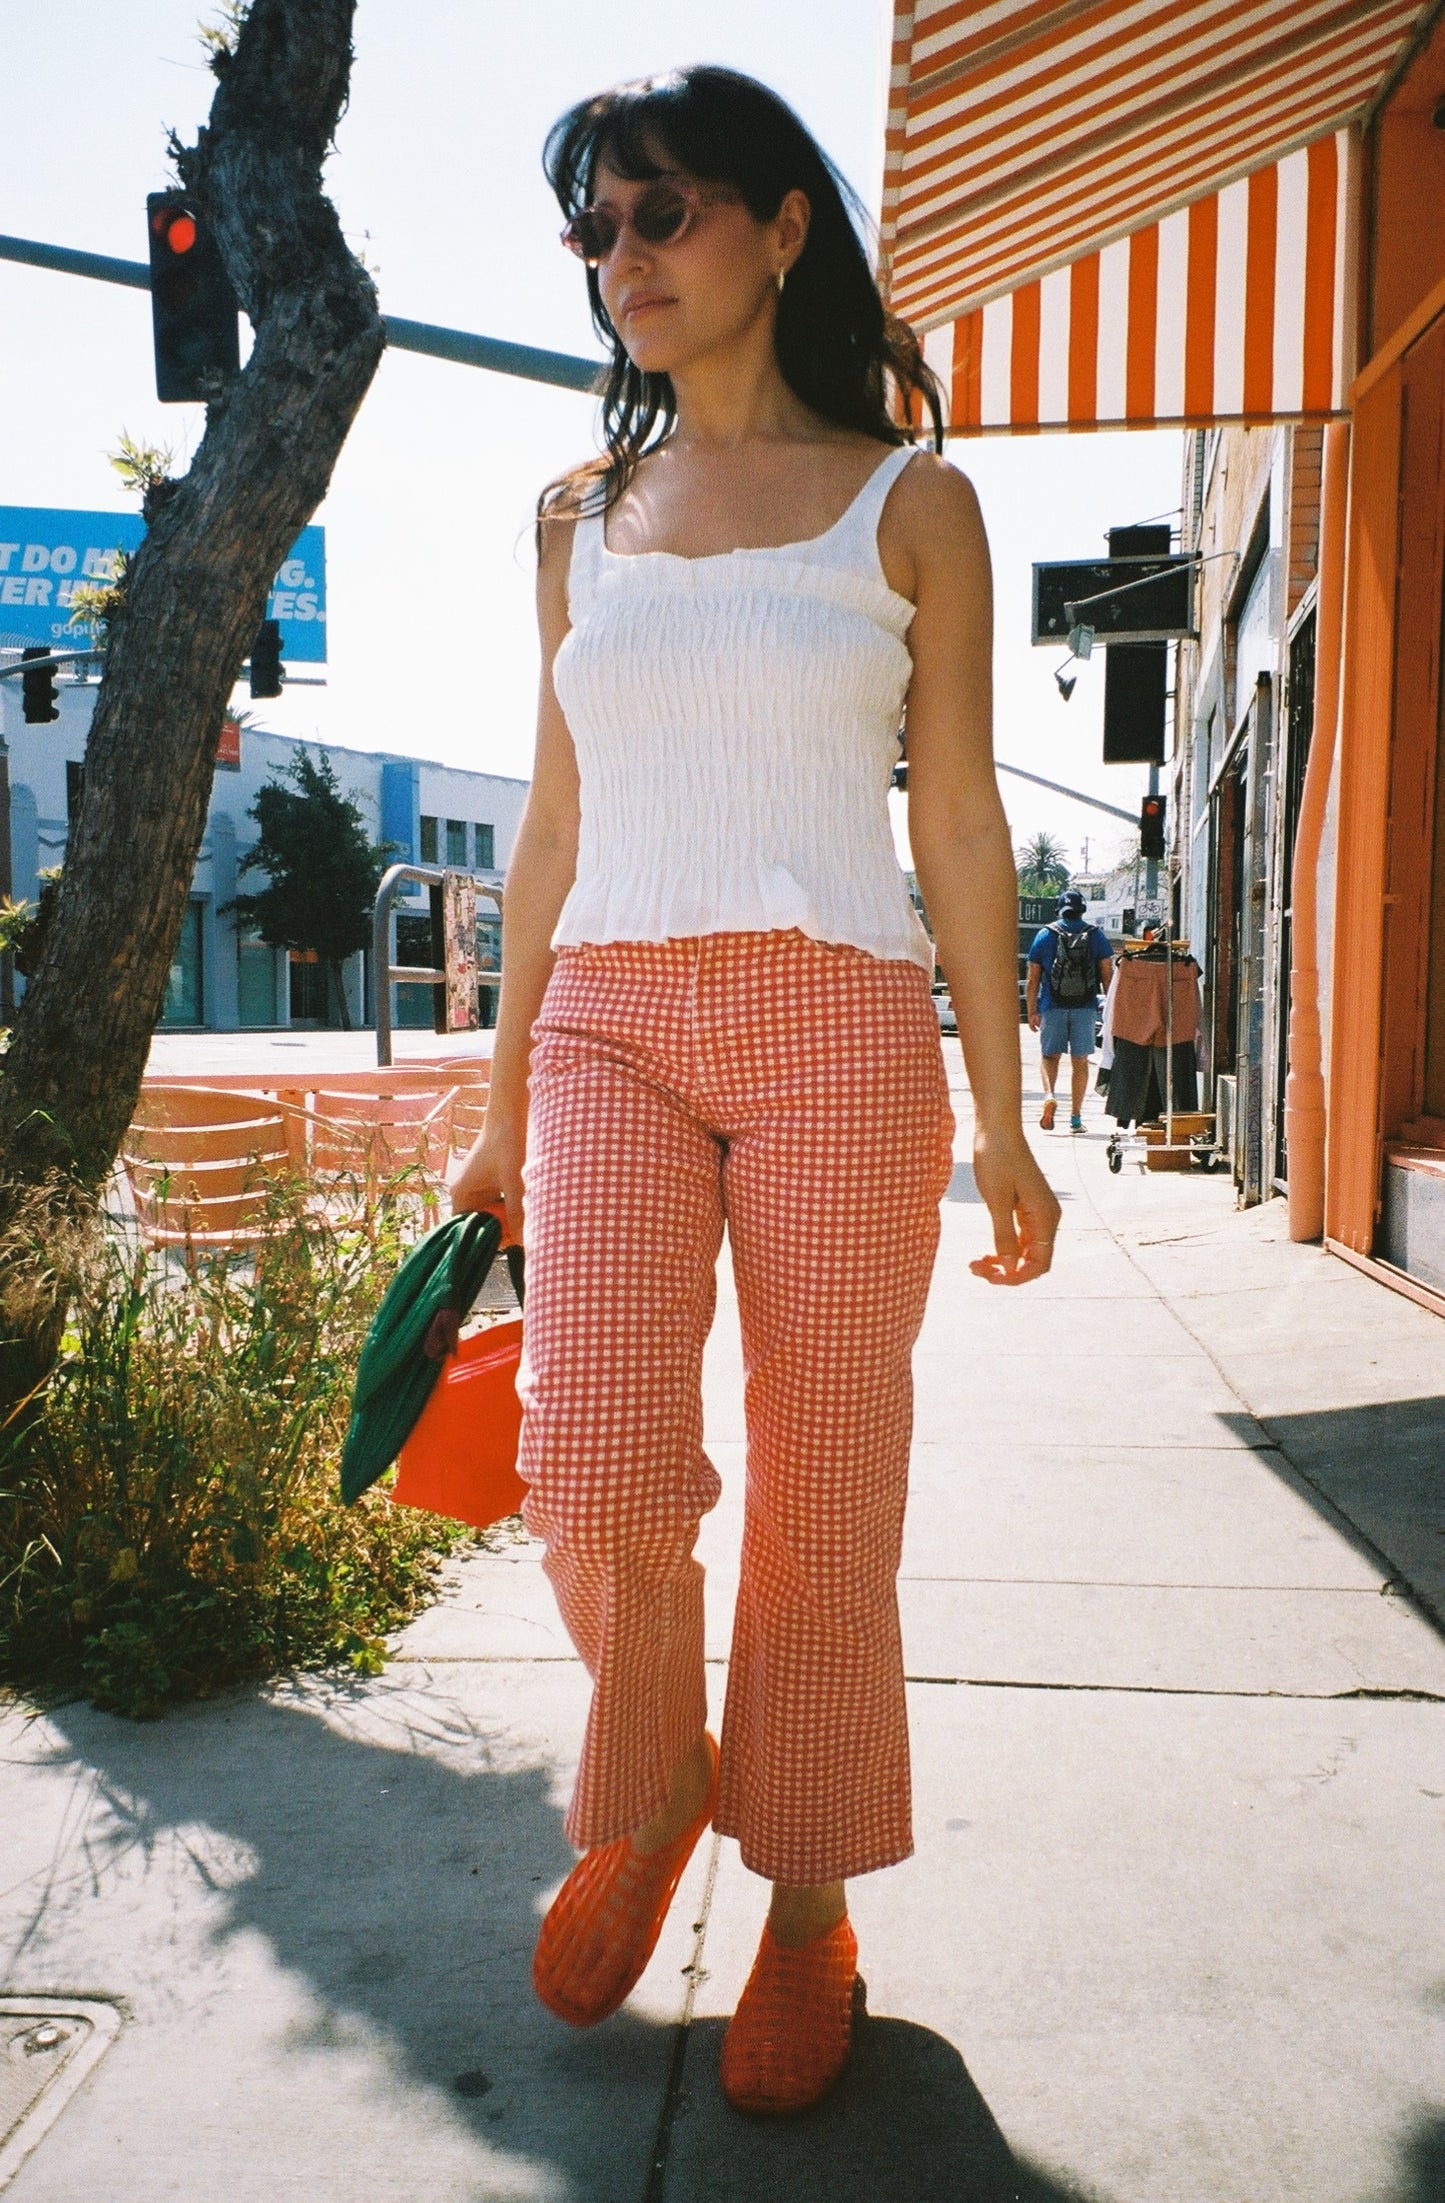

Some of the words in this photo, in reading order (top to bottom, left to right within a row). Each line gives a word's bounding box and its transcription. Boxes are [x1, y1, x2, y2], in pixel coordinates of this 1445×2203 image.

[21, 544, 77, 574] DO
[278, 559, 315, 589] G.
[0, 576, 53, 606] ER
[271, 591, 326, 622] ES.
